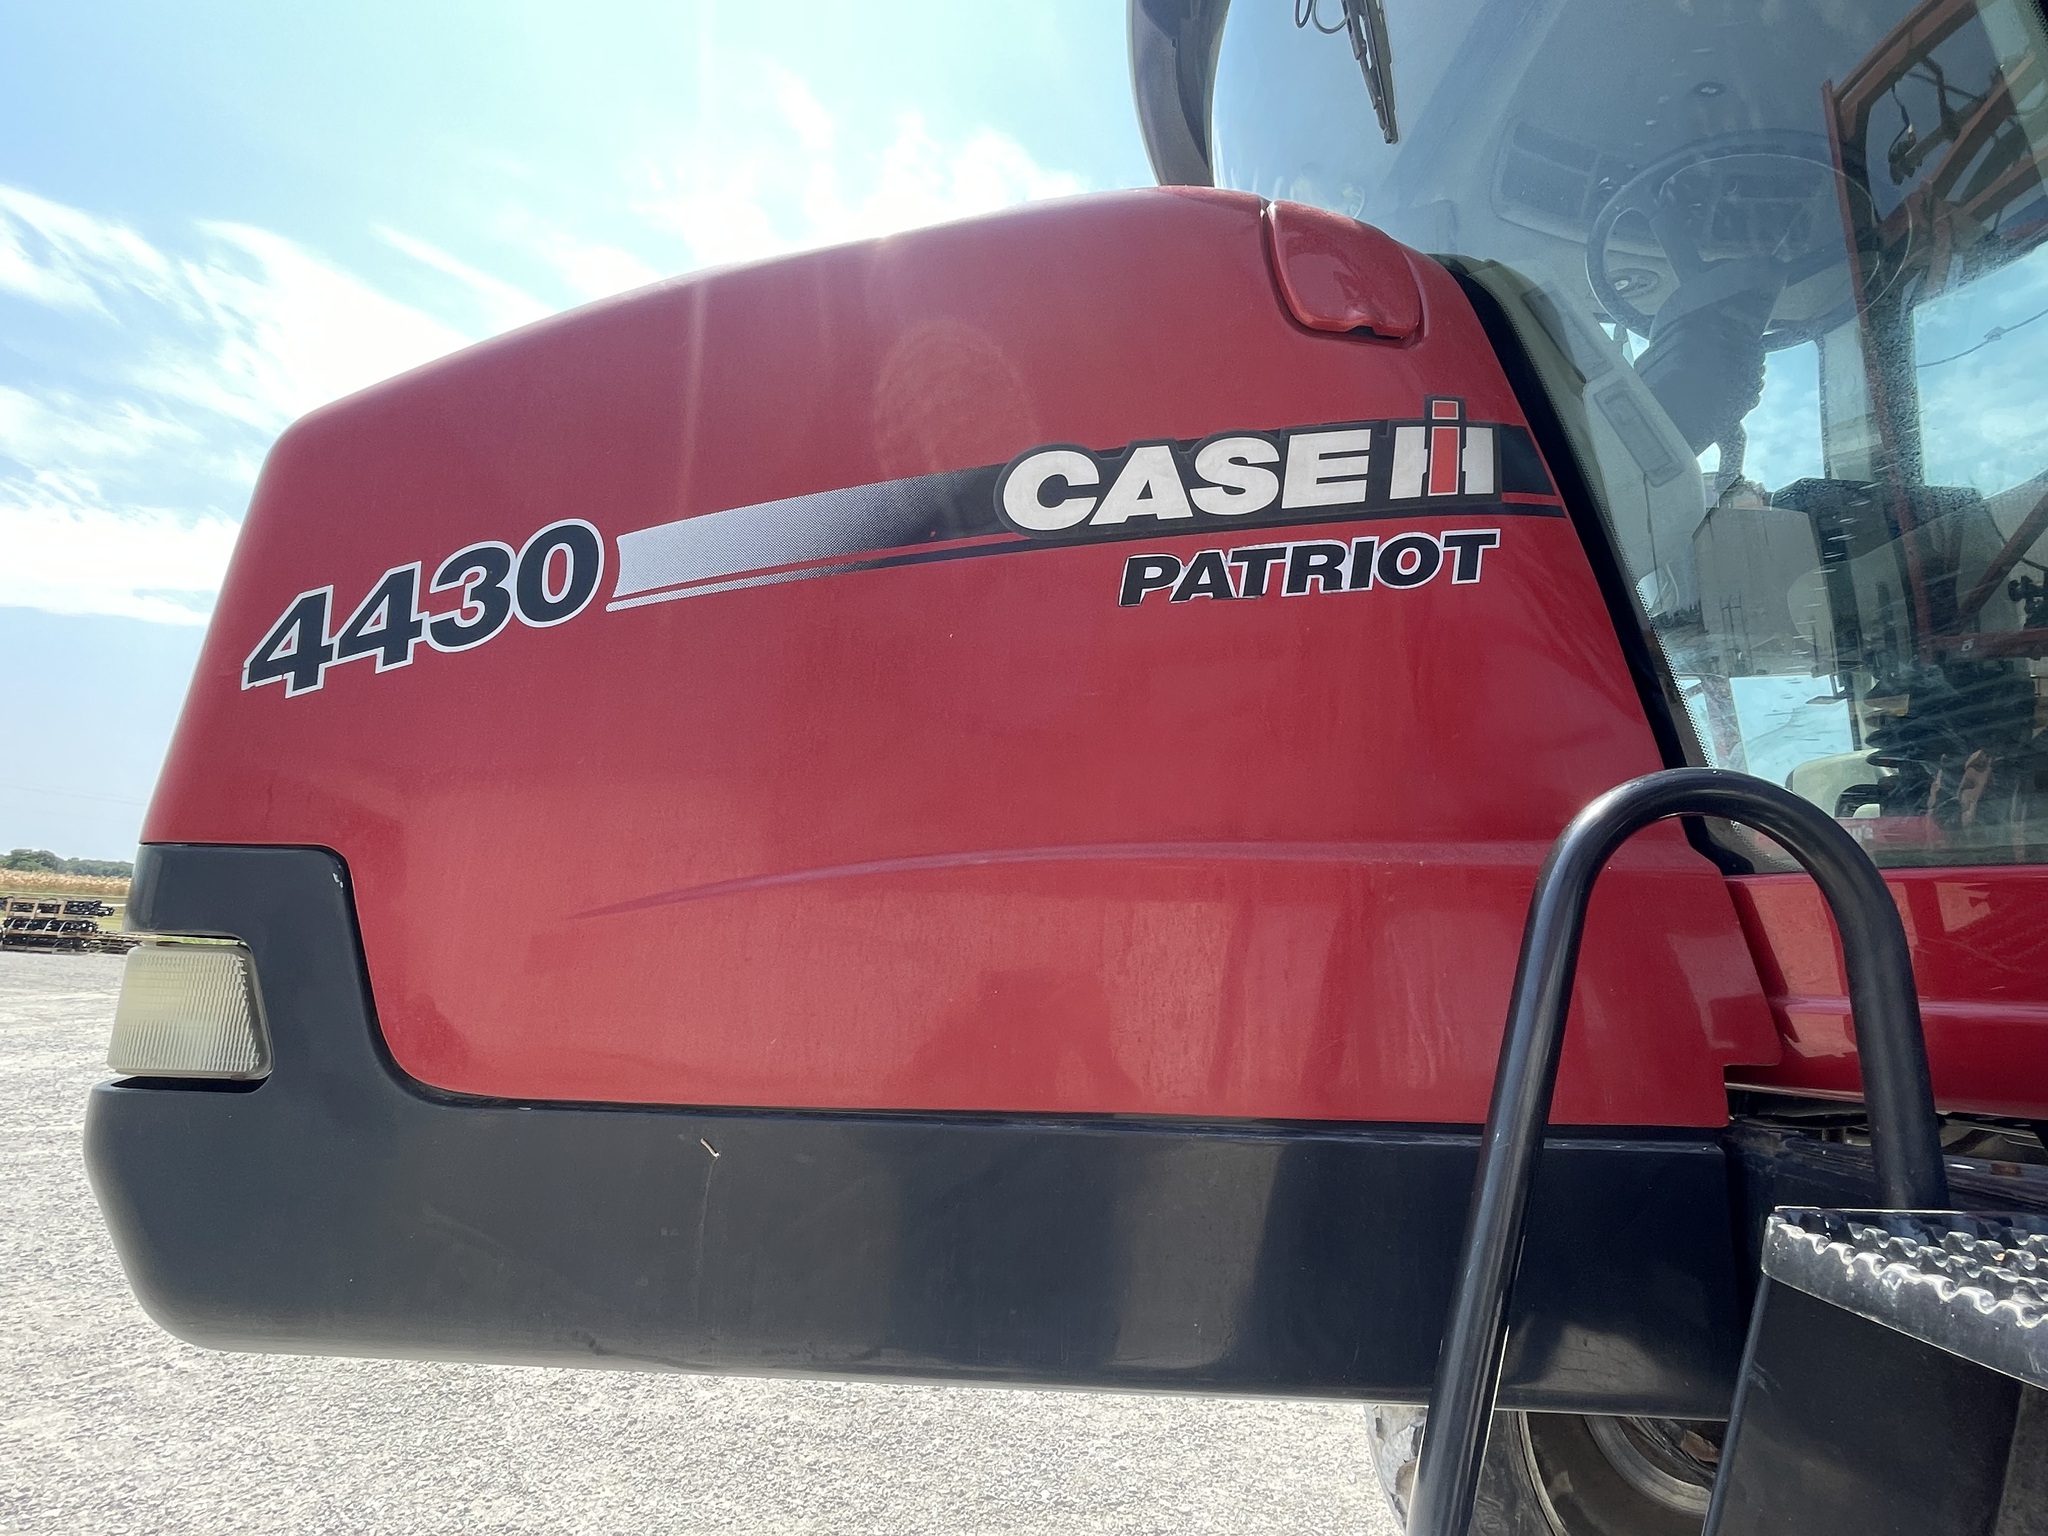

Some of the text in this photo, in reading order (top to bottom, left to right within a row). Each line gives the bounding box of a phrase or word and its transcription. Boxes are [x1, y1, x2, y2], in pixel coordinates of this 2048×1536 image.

[1003, 429, 1371, 531] CASE
[241, 518, 605, 698] 4430
[1119, 529, 1500, 607] PATRIOT
